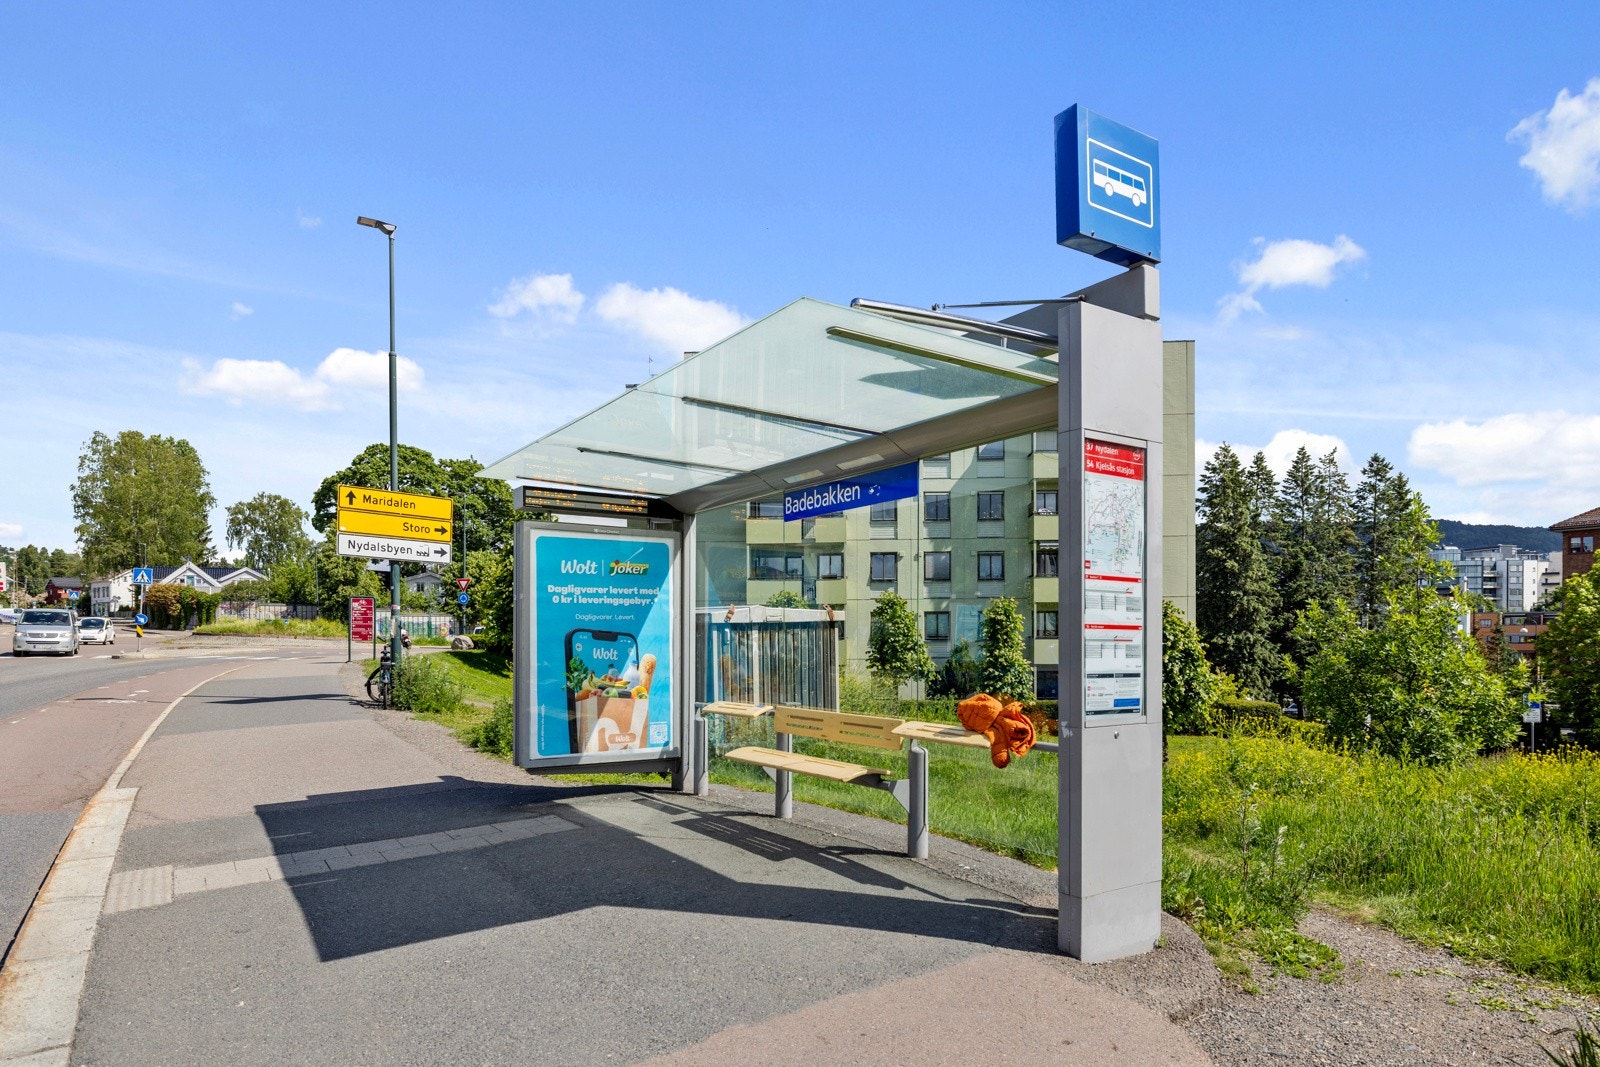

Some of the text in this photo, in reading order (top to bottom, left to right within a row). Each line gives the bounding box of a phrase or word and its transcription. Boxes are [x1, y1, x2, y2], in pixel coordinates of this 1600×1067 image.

[1095, 445, 1118, 455] Nydalen
[1086, 460, 1134, 475] 54 Kjelsås stasjon
[362, 494, 416, 509] Maridalen
[785, 484, 860, 514] Badebakken
[402, 522, 431, 534] Storo
[347, 540, 413, 555] Nydalsbyen
[560, 559, 598, 575] Wolt
[610, 560, 647, 576] joker
[547, 584, 660, 595] Dagligvarer levert med
[552, 595, 560, 603] 0
[560, 595, 572, 604] kr
[573, 594, 578, 604] i
[575, 613, 612, 622] Dagligvarer
[593, 647, 618, 661] Wolt
